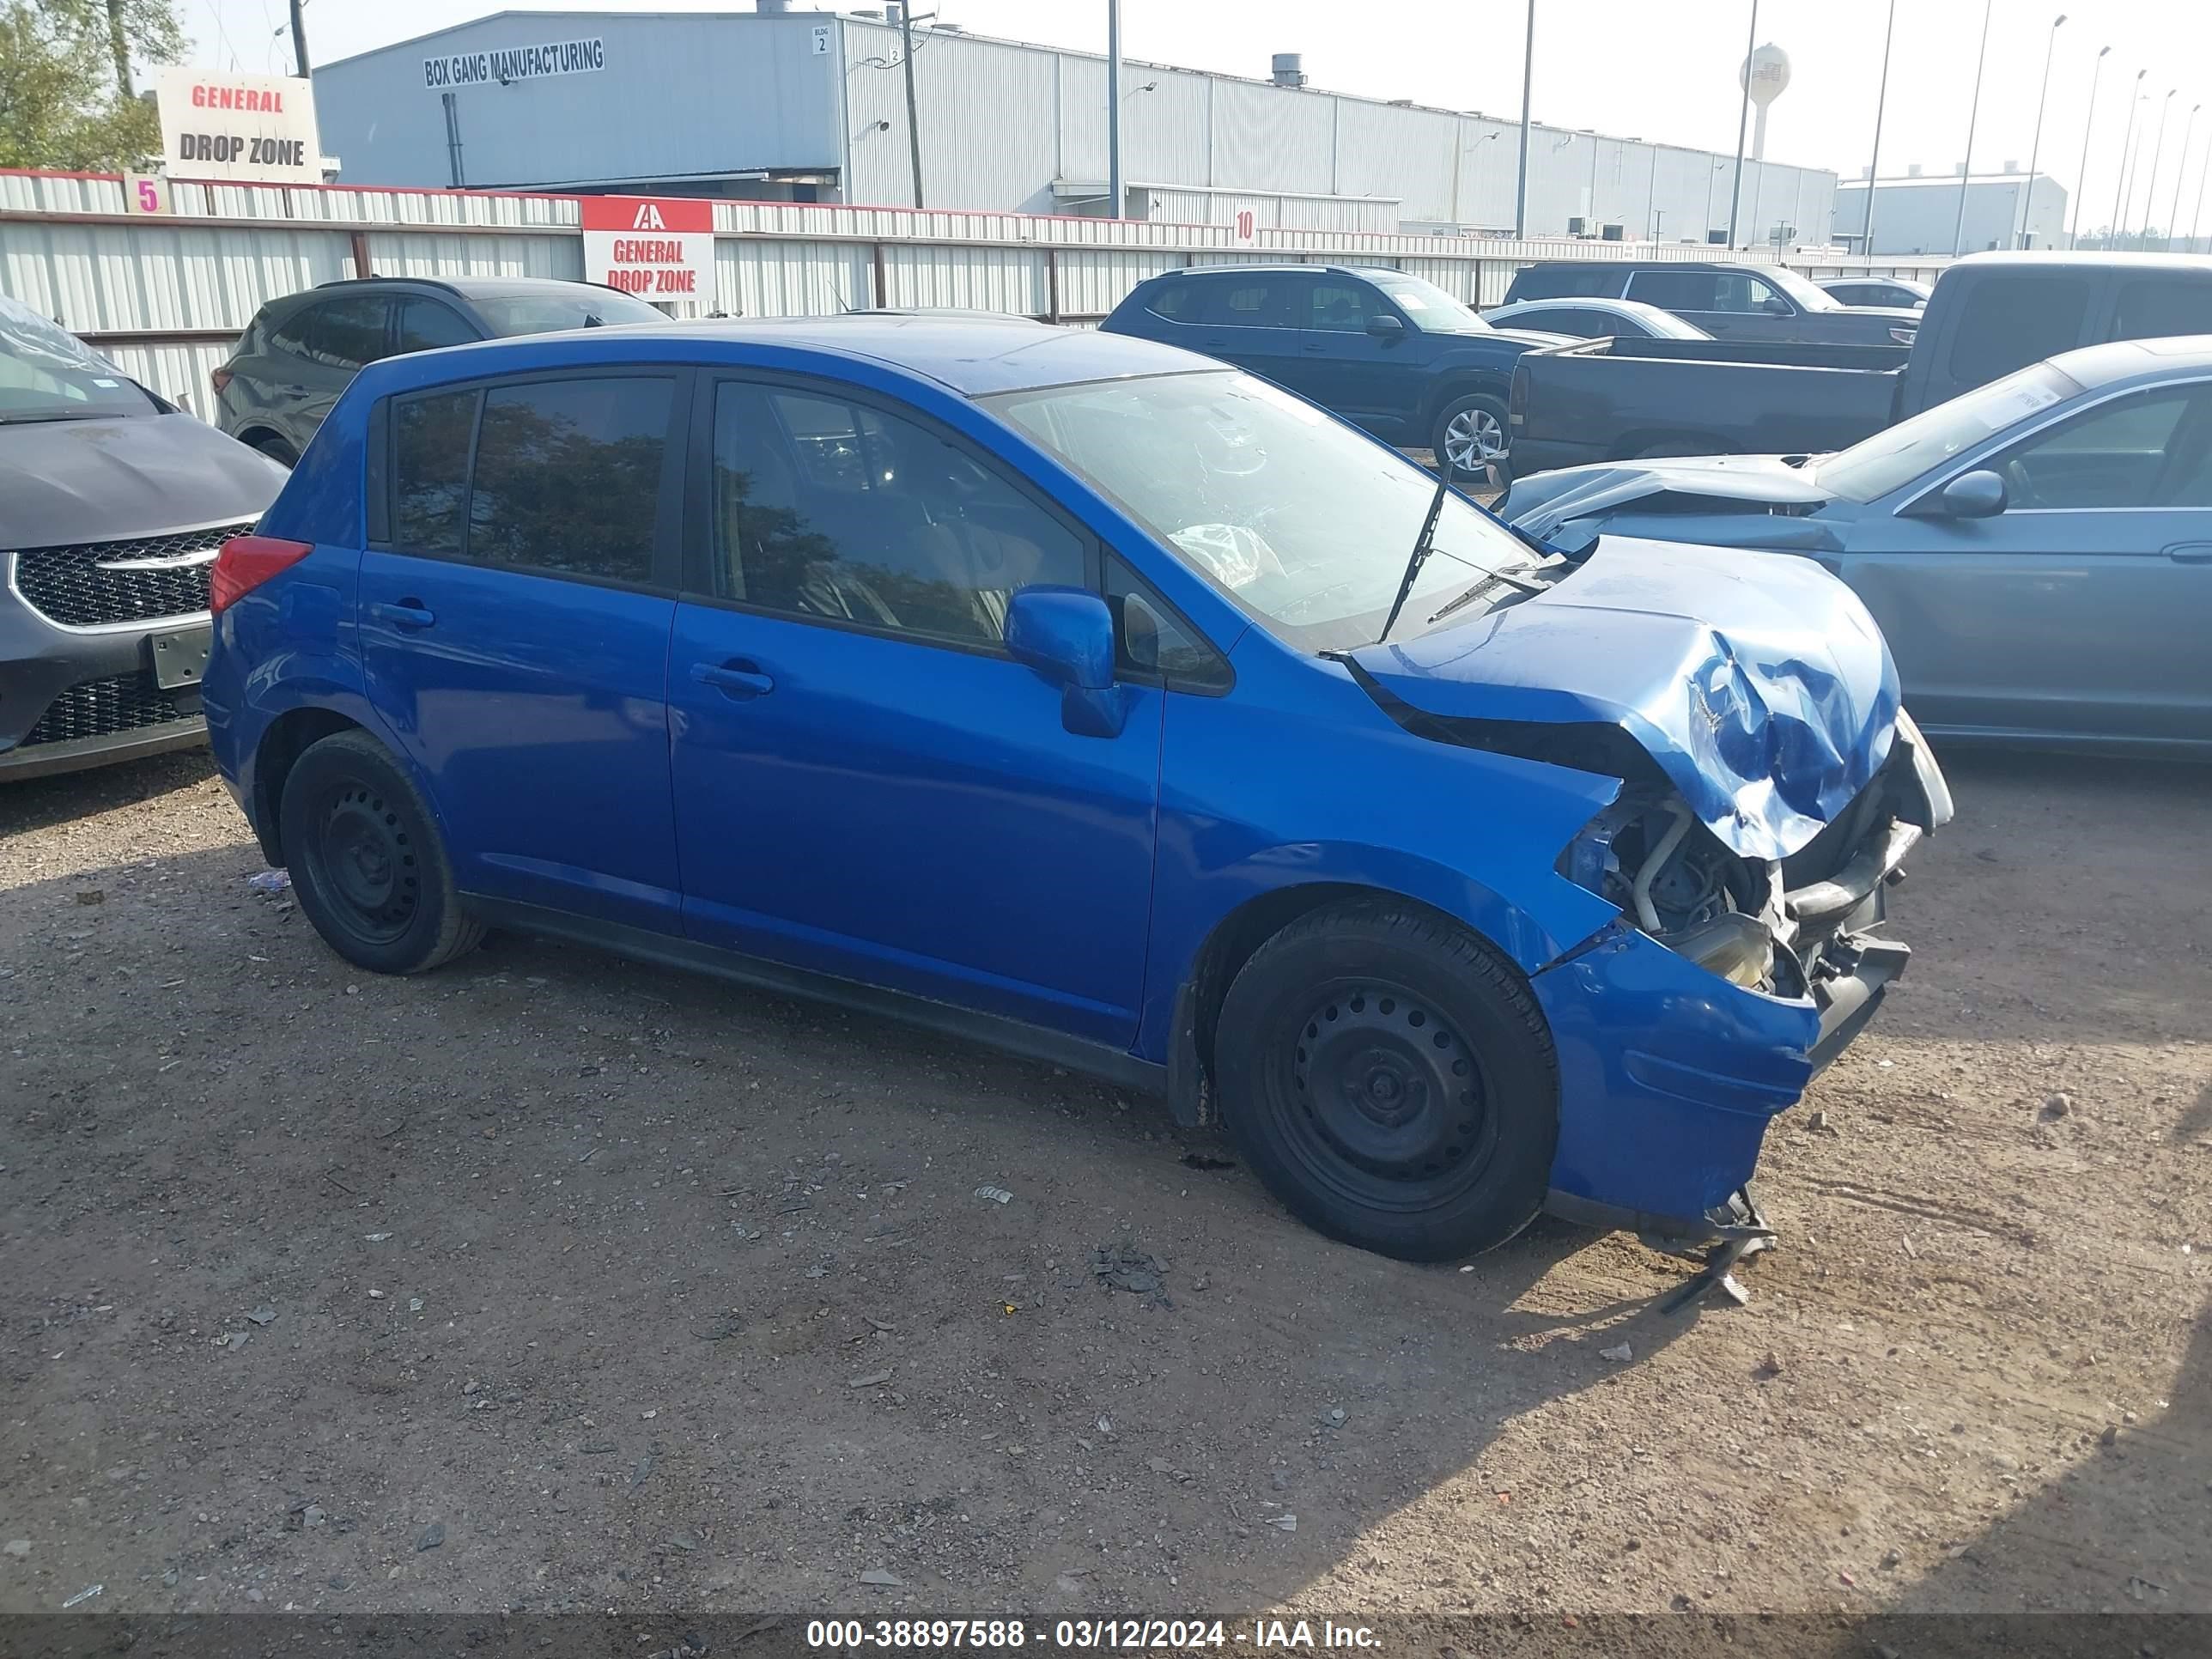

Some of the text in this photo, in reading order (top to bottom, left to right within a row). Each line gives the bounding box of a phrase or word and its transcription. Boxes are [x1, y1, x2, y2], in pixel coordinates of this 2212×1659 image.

[819, 38, 825, 51] 2
[892, 50, 898, 60] 2
[424, 40, 604, 87] BOX GANG MANUFACTURING
[191, 85, 283, 113] GENERAL
[179, 133, 304, 166] DROP ZONE
[137, 180, 158, 212] 5
[1237, 211, 1253, 239] 10
[613, 239, 684, 264] GENERAL
[607, 270, 696, 294] DROP ZONE
